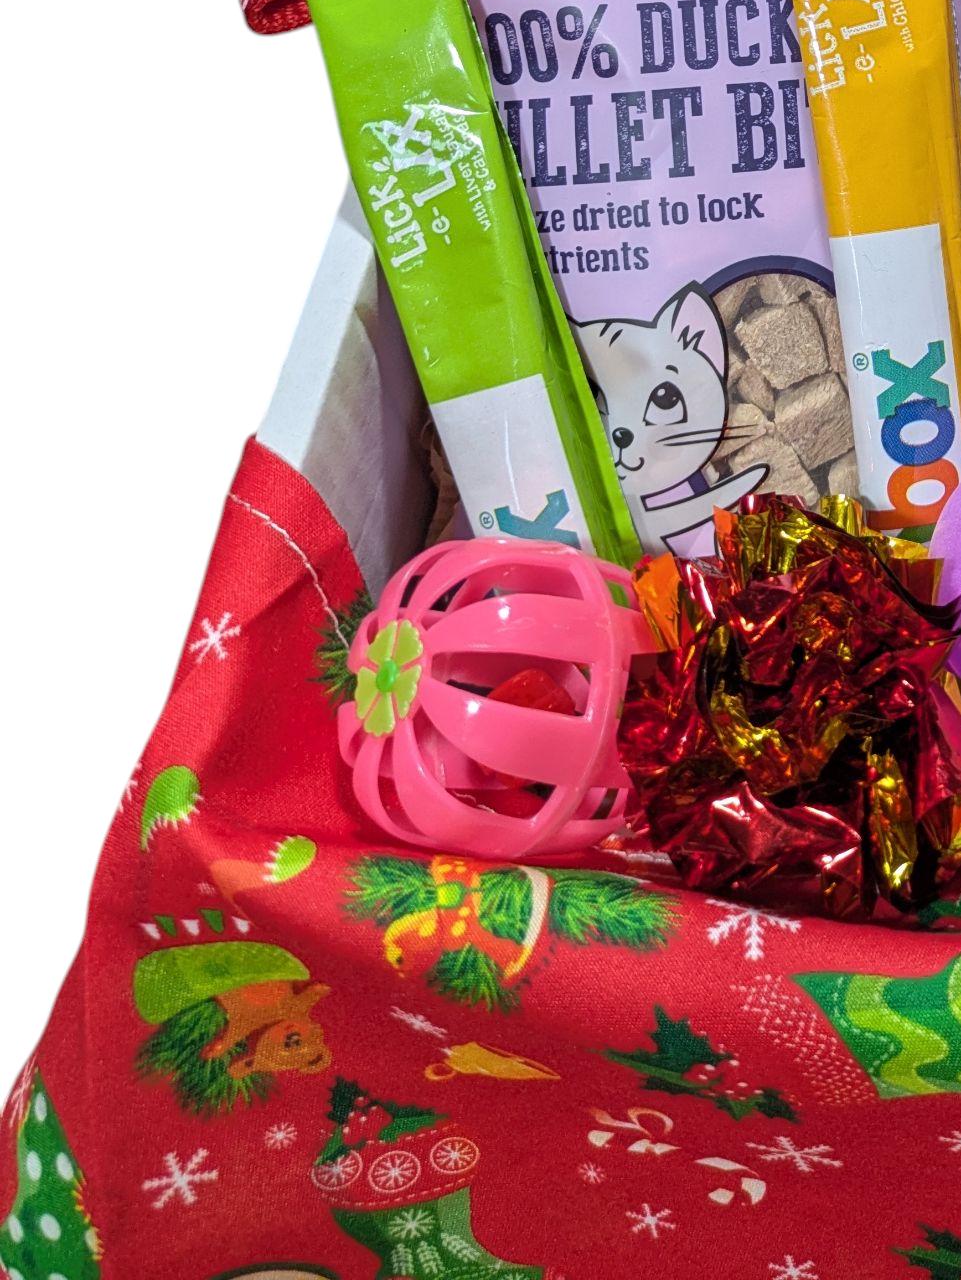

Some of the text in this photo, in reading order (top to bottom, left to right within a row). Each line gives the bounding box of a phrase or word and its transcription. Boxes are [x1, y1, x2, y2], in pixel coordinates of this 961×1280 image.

[484, 4, 619, 86] 00%
[496, 78, 809, 188] ILLET BI
[535, 192, 764, 233] ze dried to lock
[544, 242, 649, 274] trients
